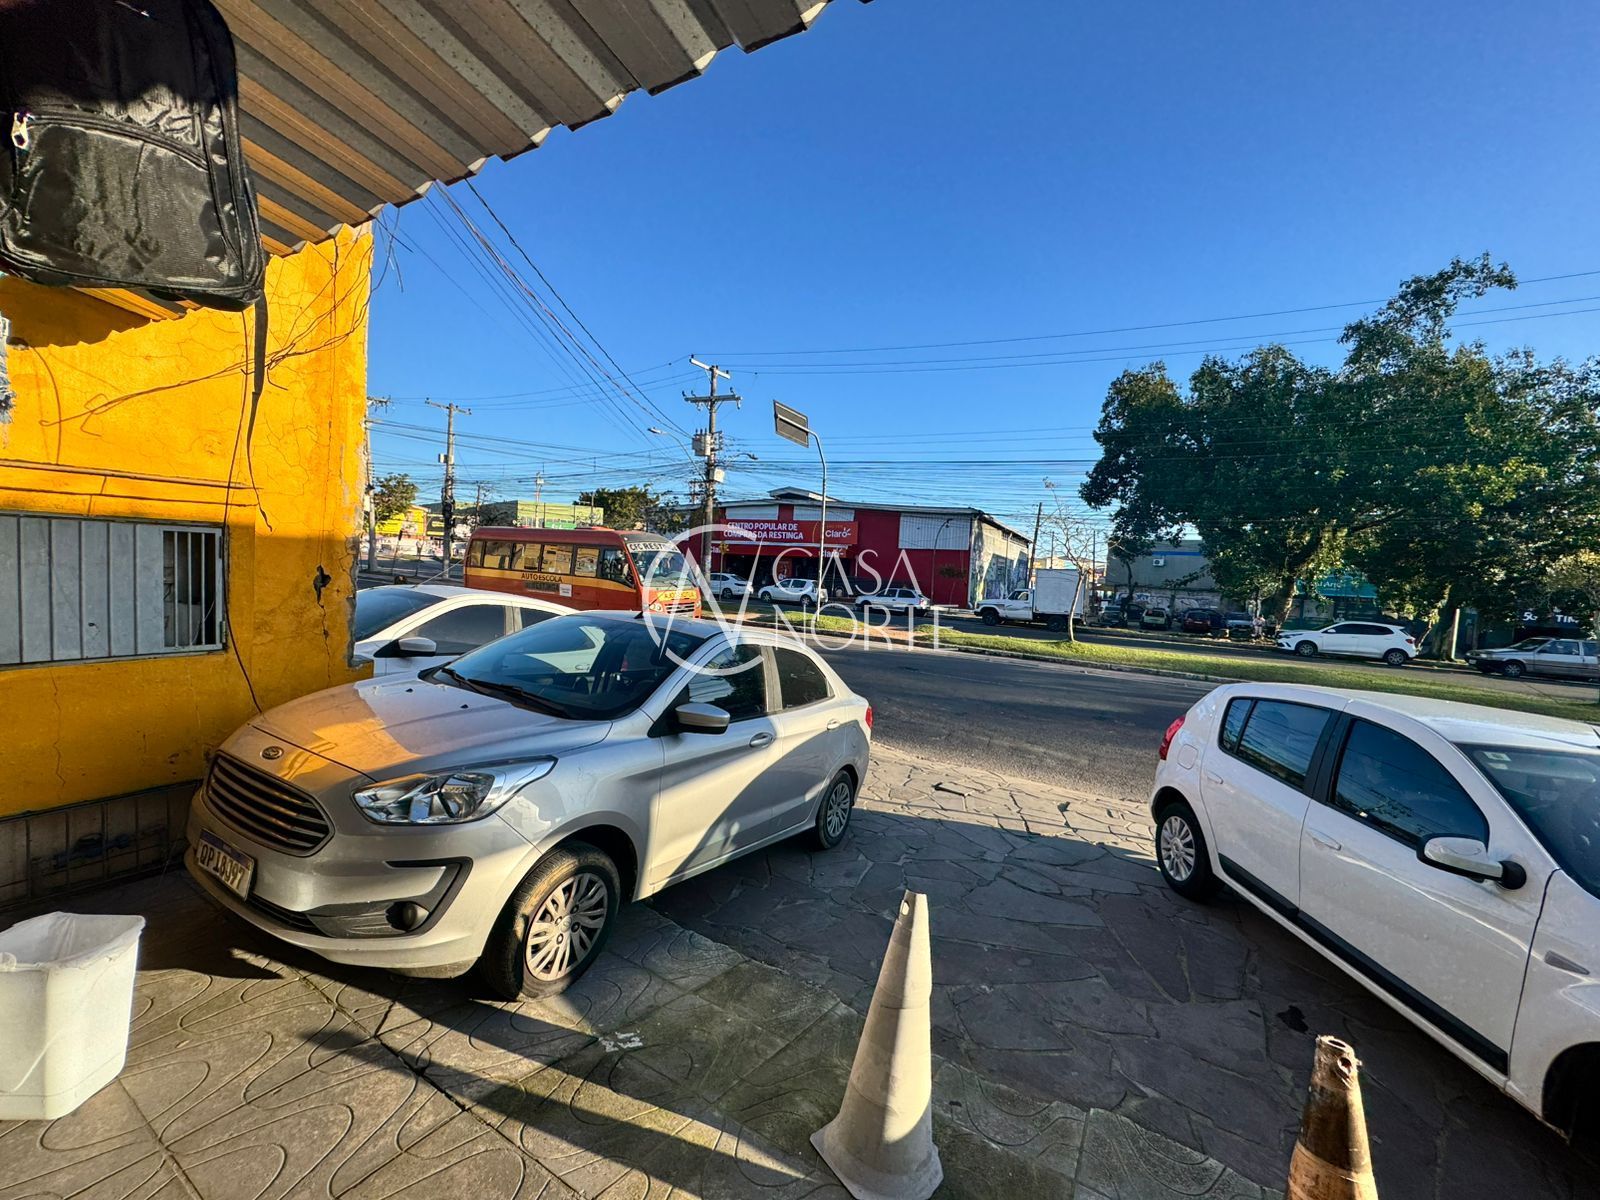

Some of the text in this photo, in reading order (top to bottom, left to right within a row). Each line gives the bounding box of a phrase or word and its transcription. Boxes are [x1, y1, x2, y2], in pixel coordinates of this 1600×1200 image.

[728, 522, 798, 531] CENTRO POPULAR DE
[724, 530, 804, 540] COMPRAS DA RESTINGA
[825, 528, 849, 538] Claro
